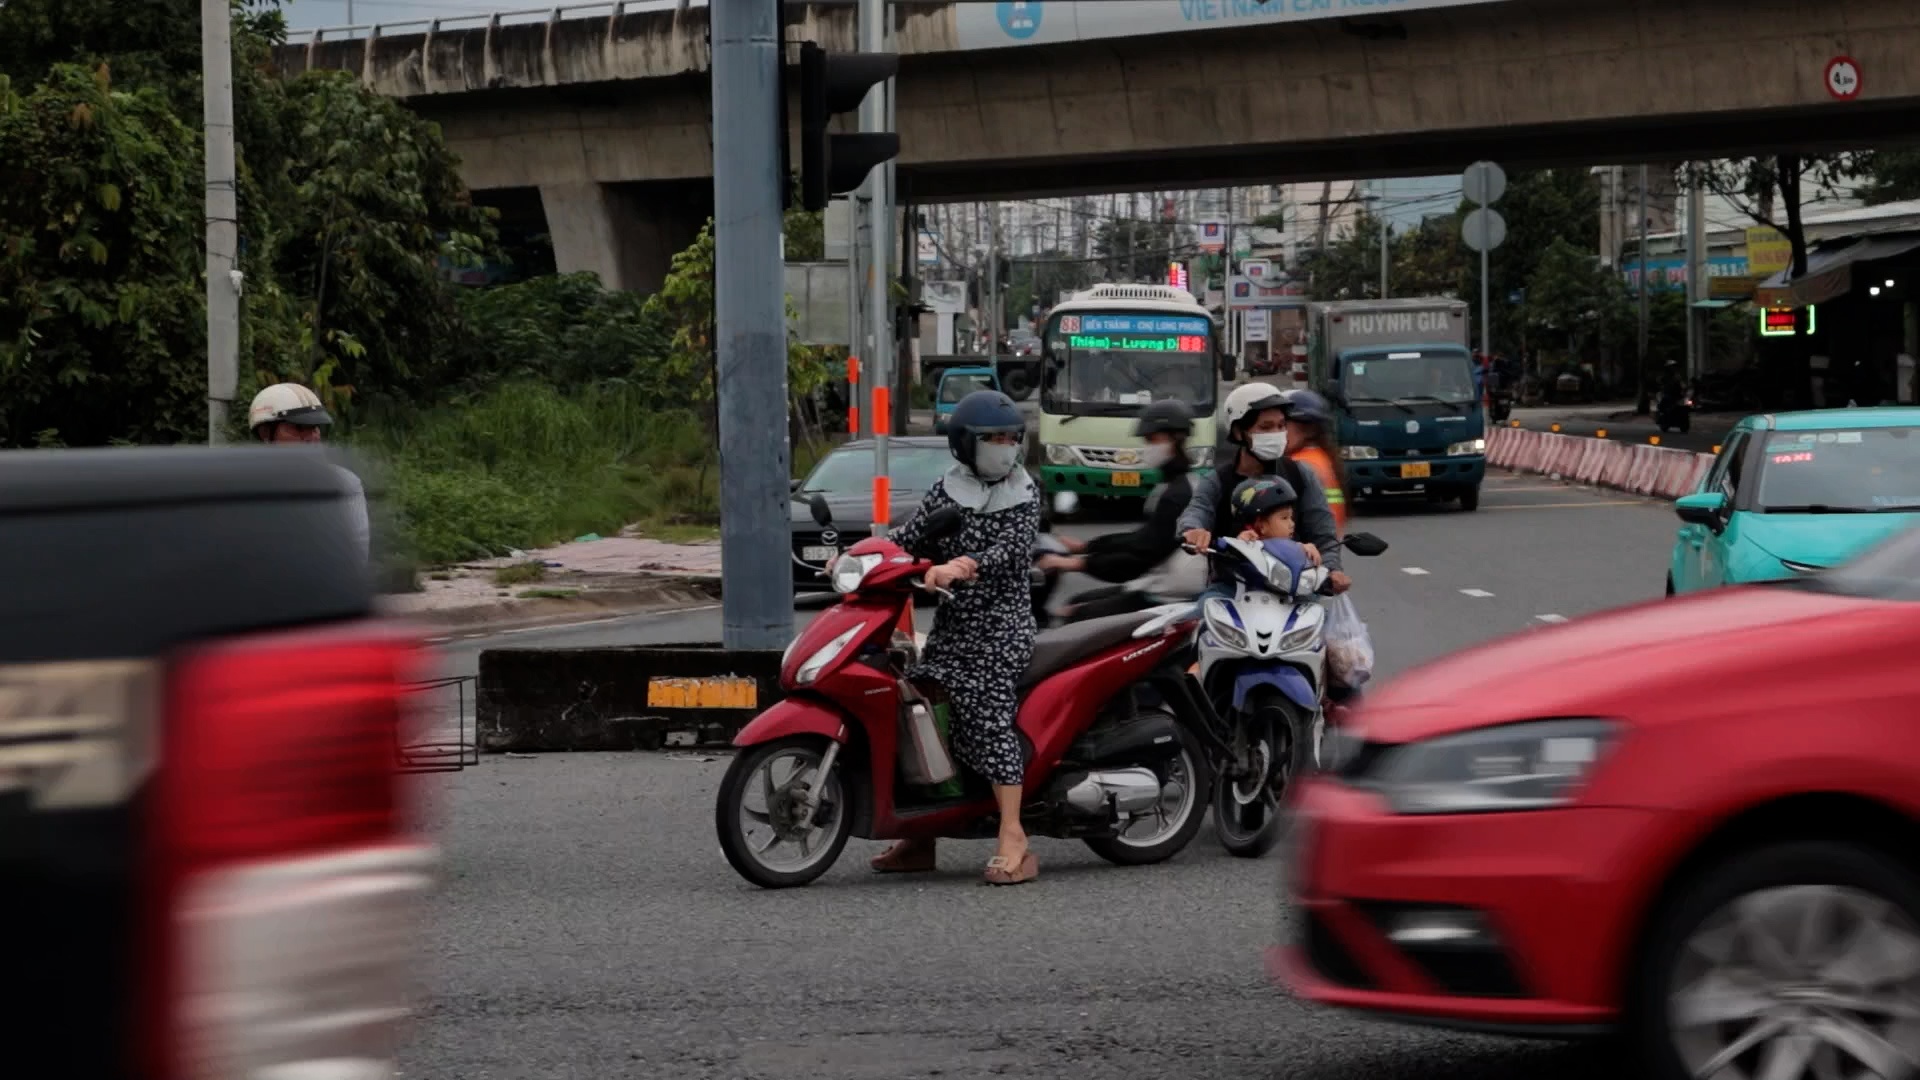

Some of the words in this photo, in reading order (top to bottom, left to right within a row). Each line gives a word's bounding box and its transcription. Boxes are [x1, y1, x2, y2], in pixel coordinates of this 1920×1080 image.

[1062, 318, 1080, 332] 88
[1417, 311, 1449, 331] GIA
[1773, 452, 1814, 464] TAXI
